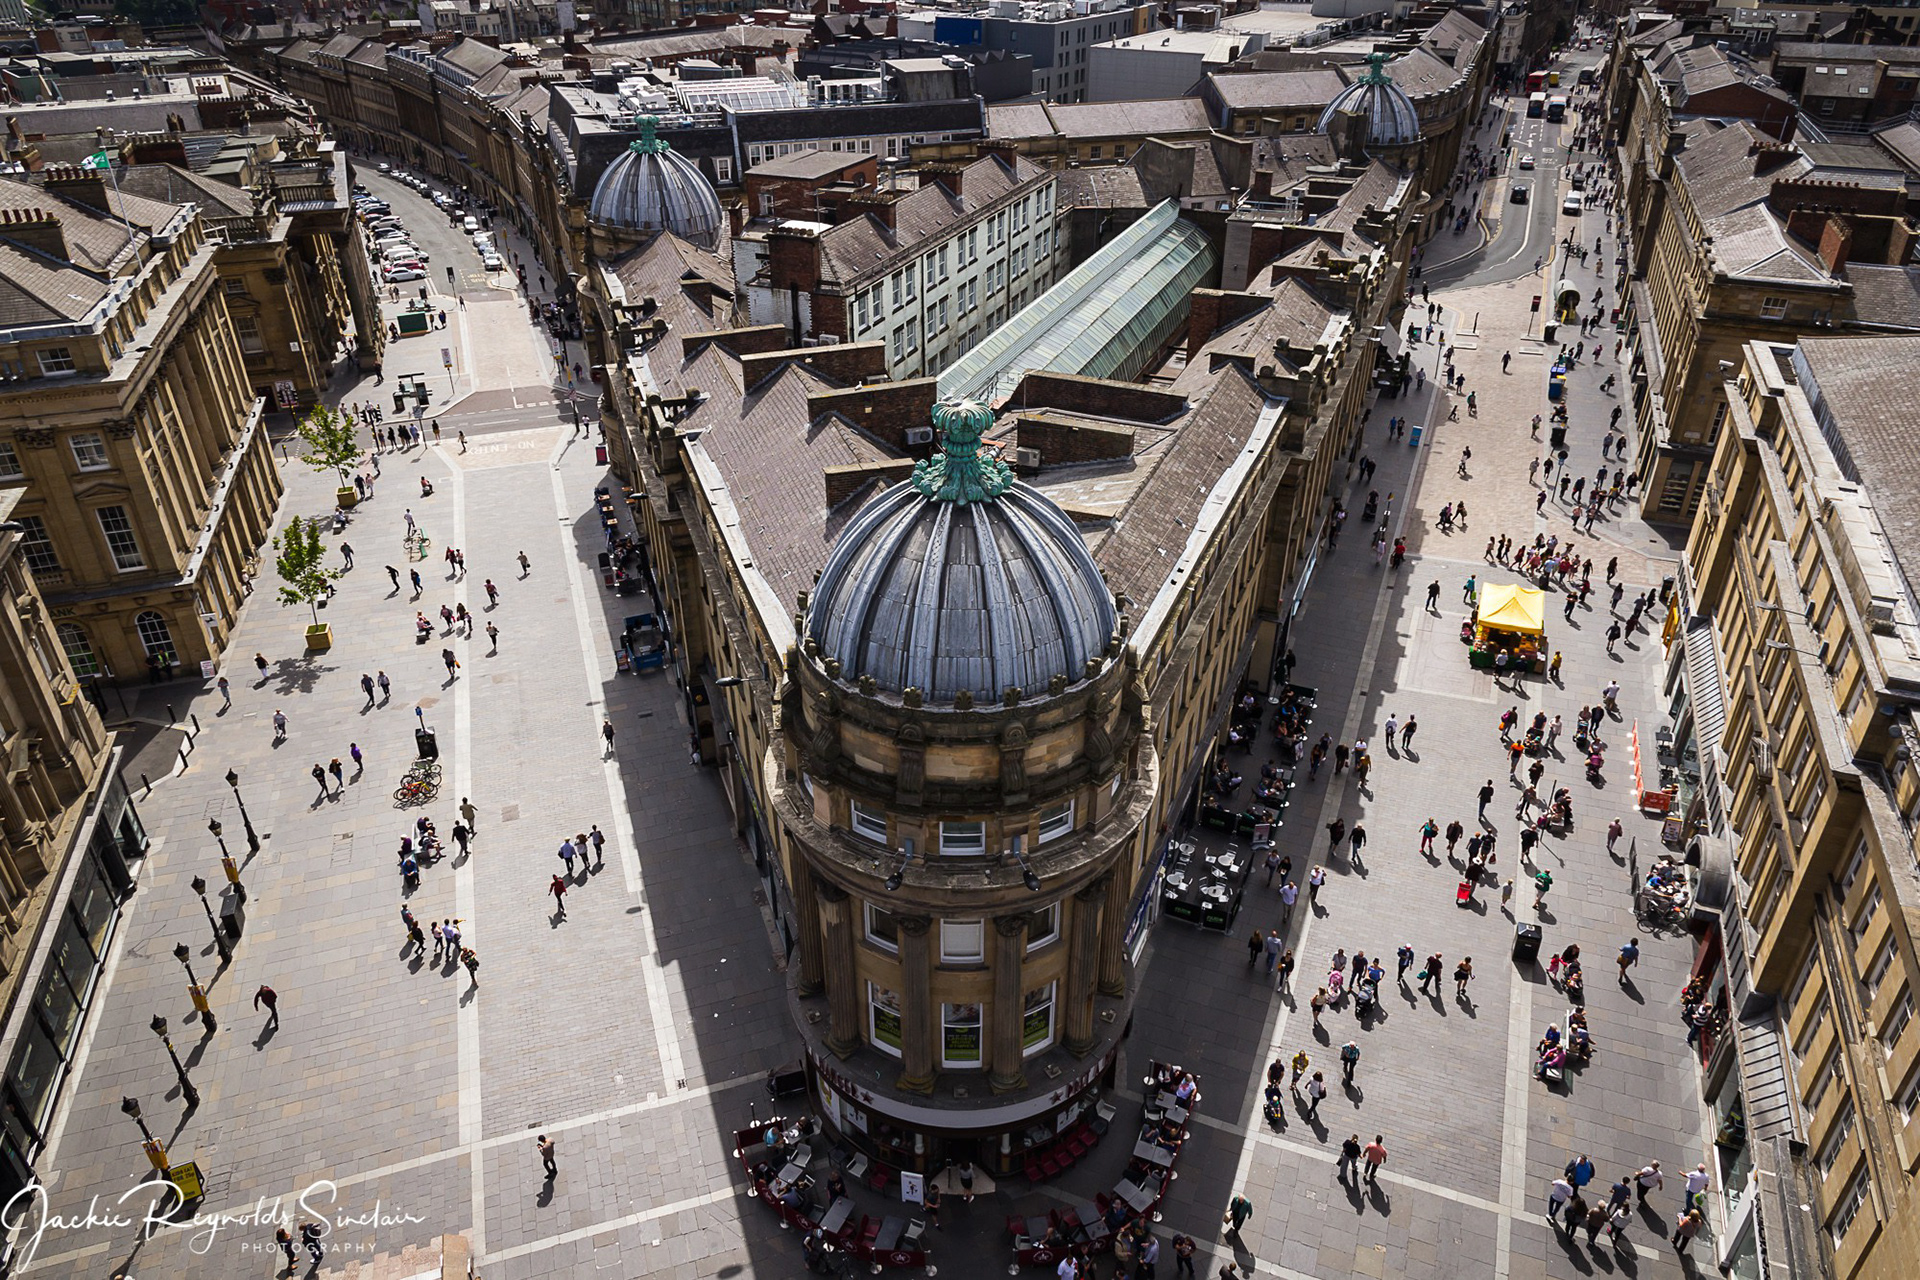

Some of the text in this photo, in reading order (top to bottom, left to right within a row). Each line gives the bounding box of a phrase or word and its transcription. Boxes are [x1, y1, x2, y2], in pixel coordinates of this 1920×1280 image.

[466, 440, 535, 456] NO ENTRY
[49, 606, 75, 617] ANK
